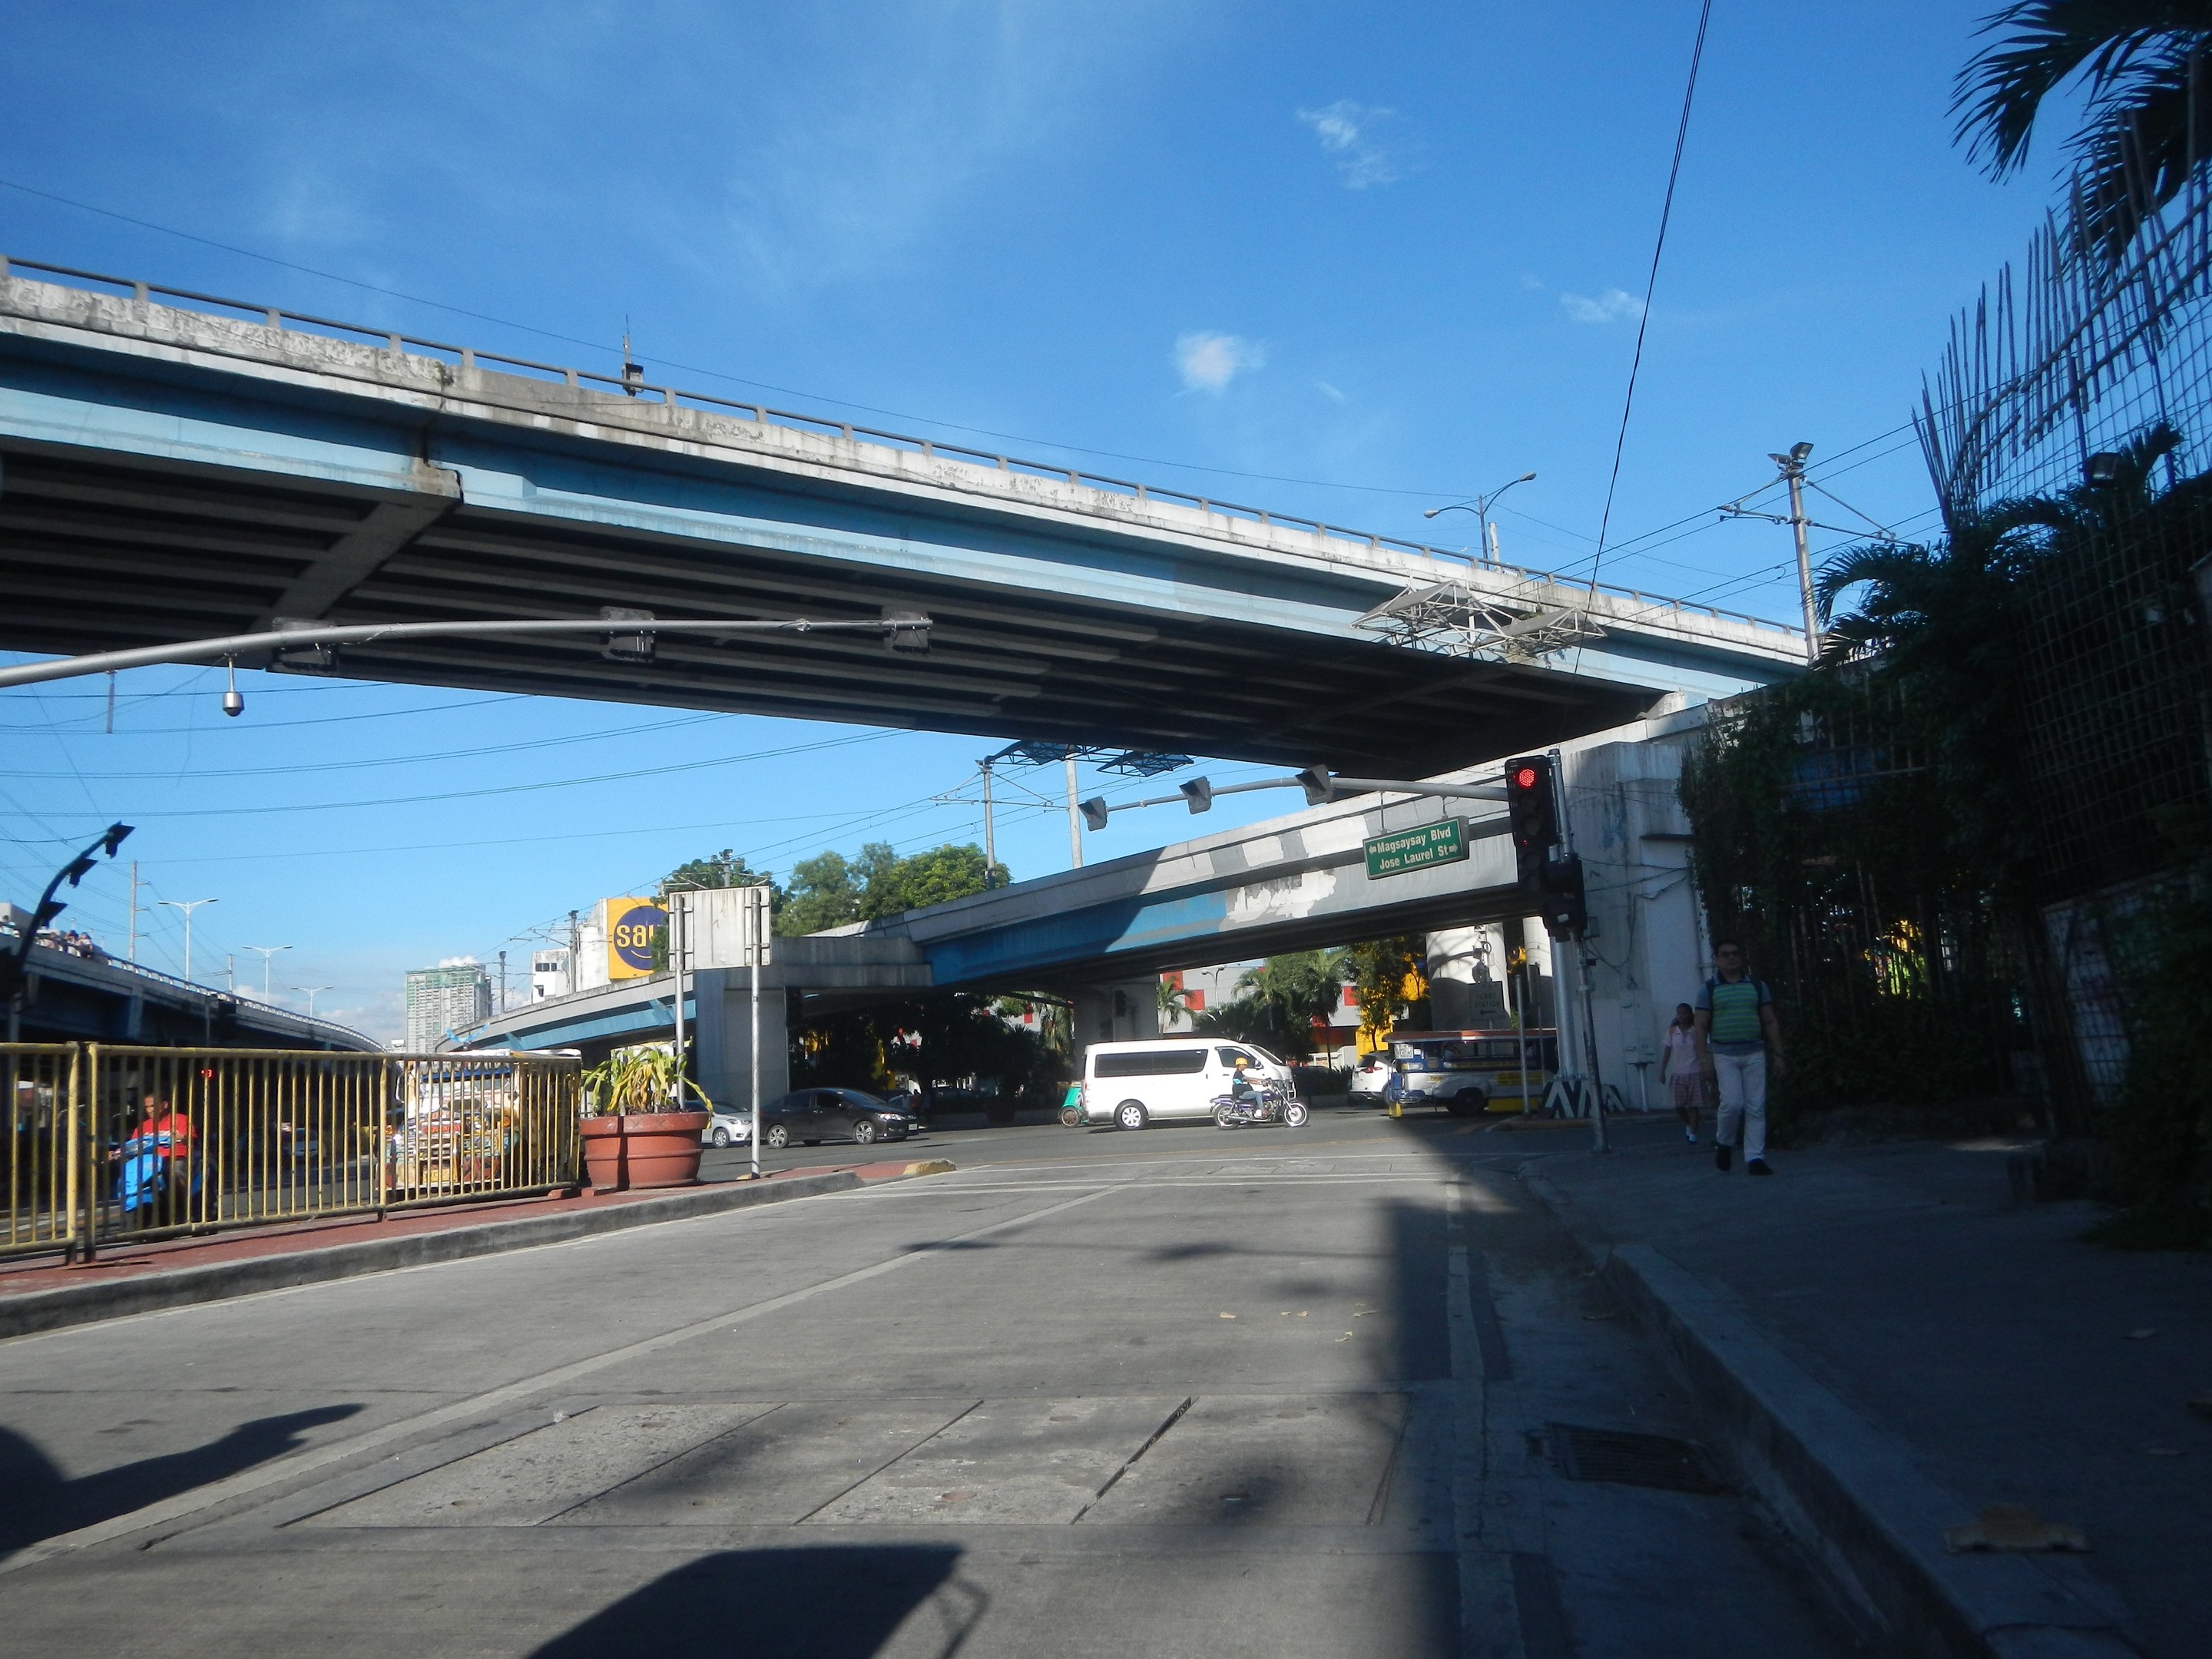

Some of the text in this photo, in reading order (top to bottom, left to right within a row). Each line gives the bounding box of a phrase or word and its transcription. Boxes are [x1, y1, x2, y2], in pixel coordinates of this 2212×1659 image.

[1376, 826, 1451, 853] Magsaysay Blvd
[1379, 844, 1449, 870] Jose Laurel St
